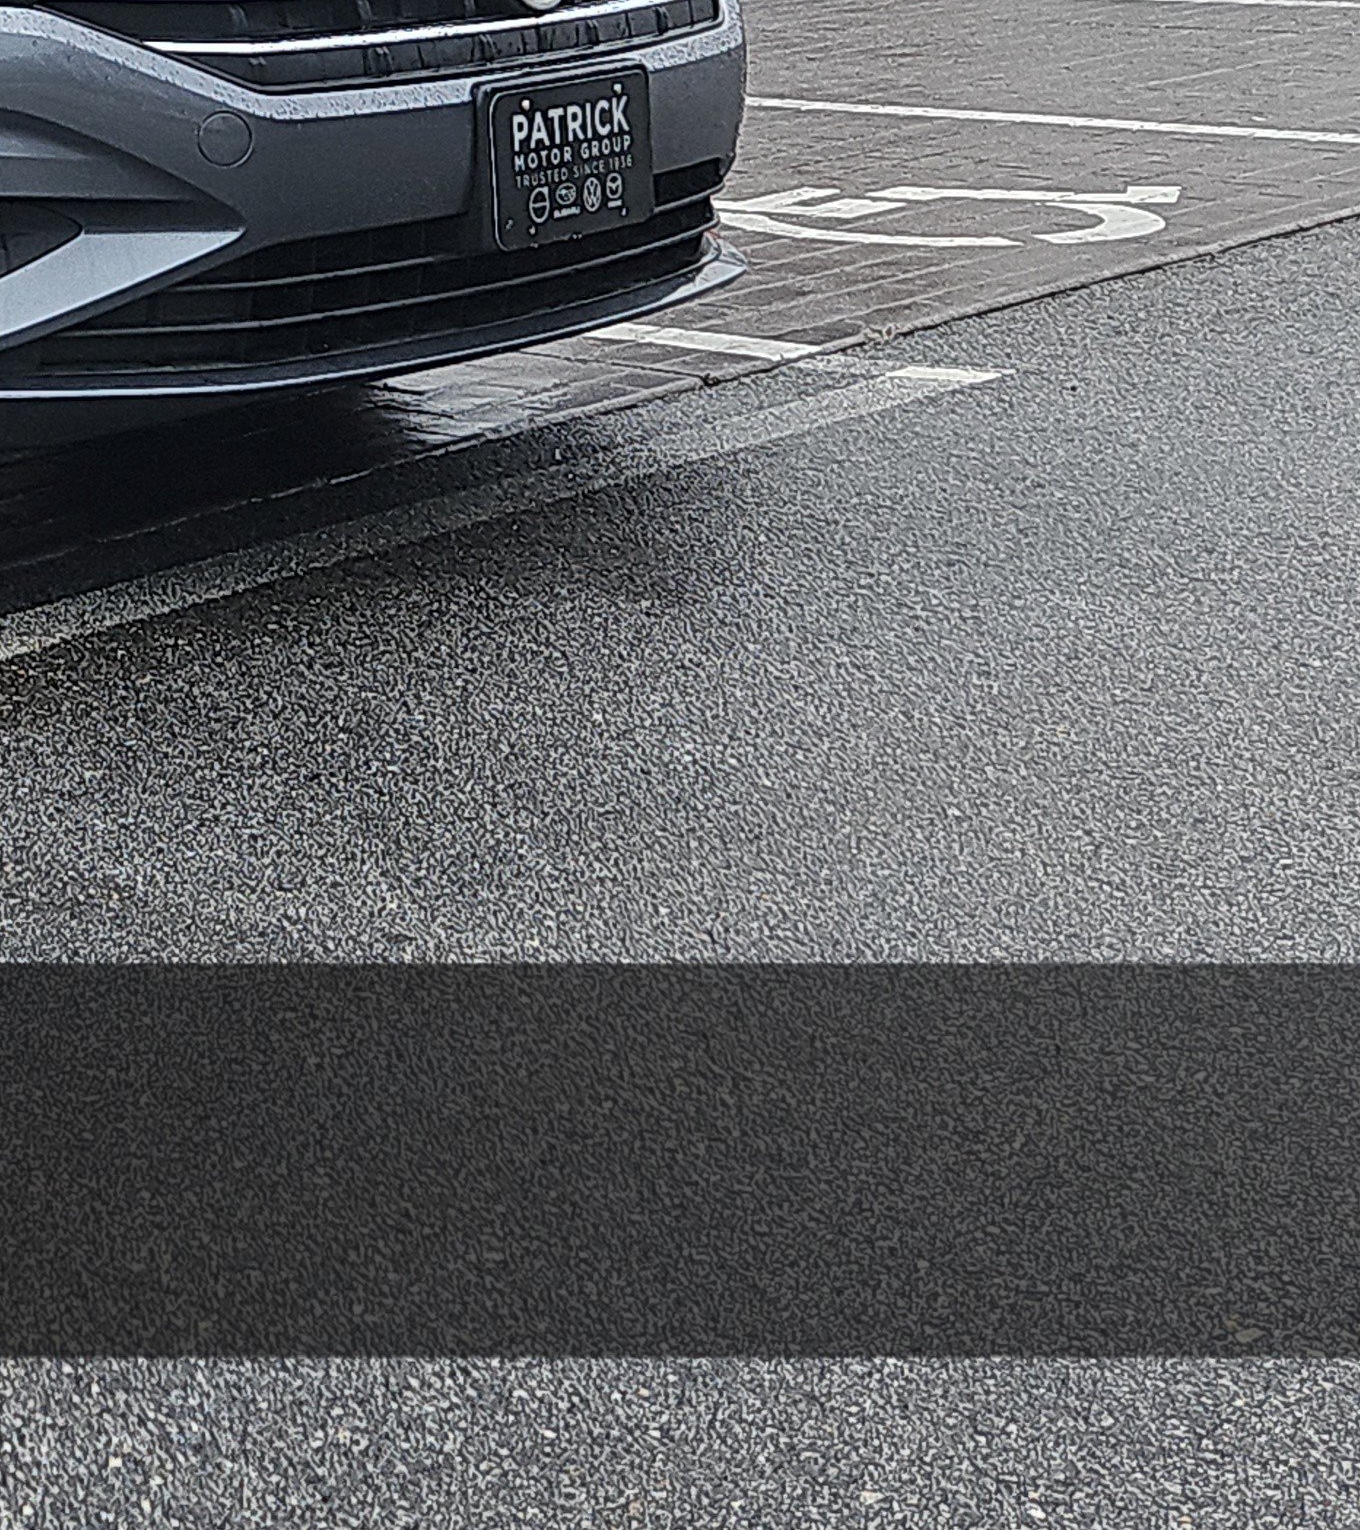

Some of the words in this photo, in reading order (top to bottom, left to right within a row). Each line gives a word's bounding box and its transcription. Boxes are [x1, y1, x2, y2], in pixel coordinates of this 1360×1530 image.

[512, 95, 631, 152] PATRICK
[514, 146, 573, 173] MOTOR
[580, 134, 632, 160] GROUP
[515, 166, 569, 189] TRUSTED
[573, 159, 605, 179] SINCE
